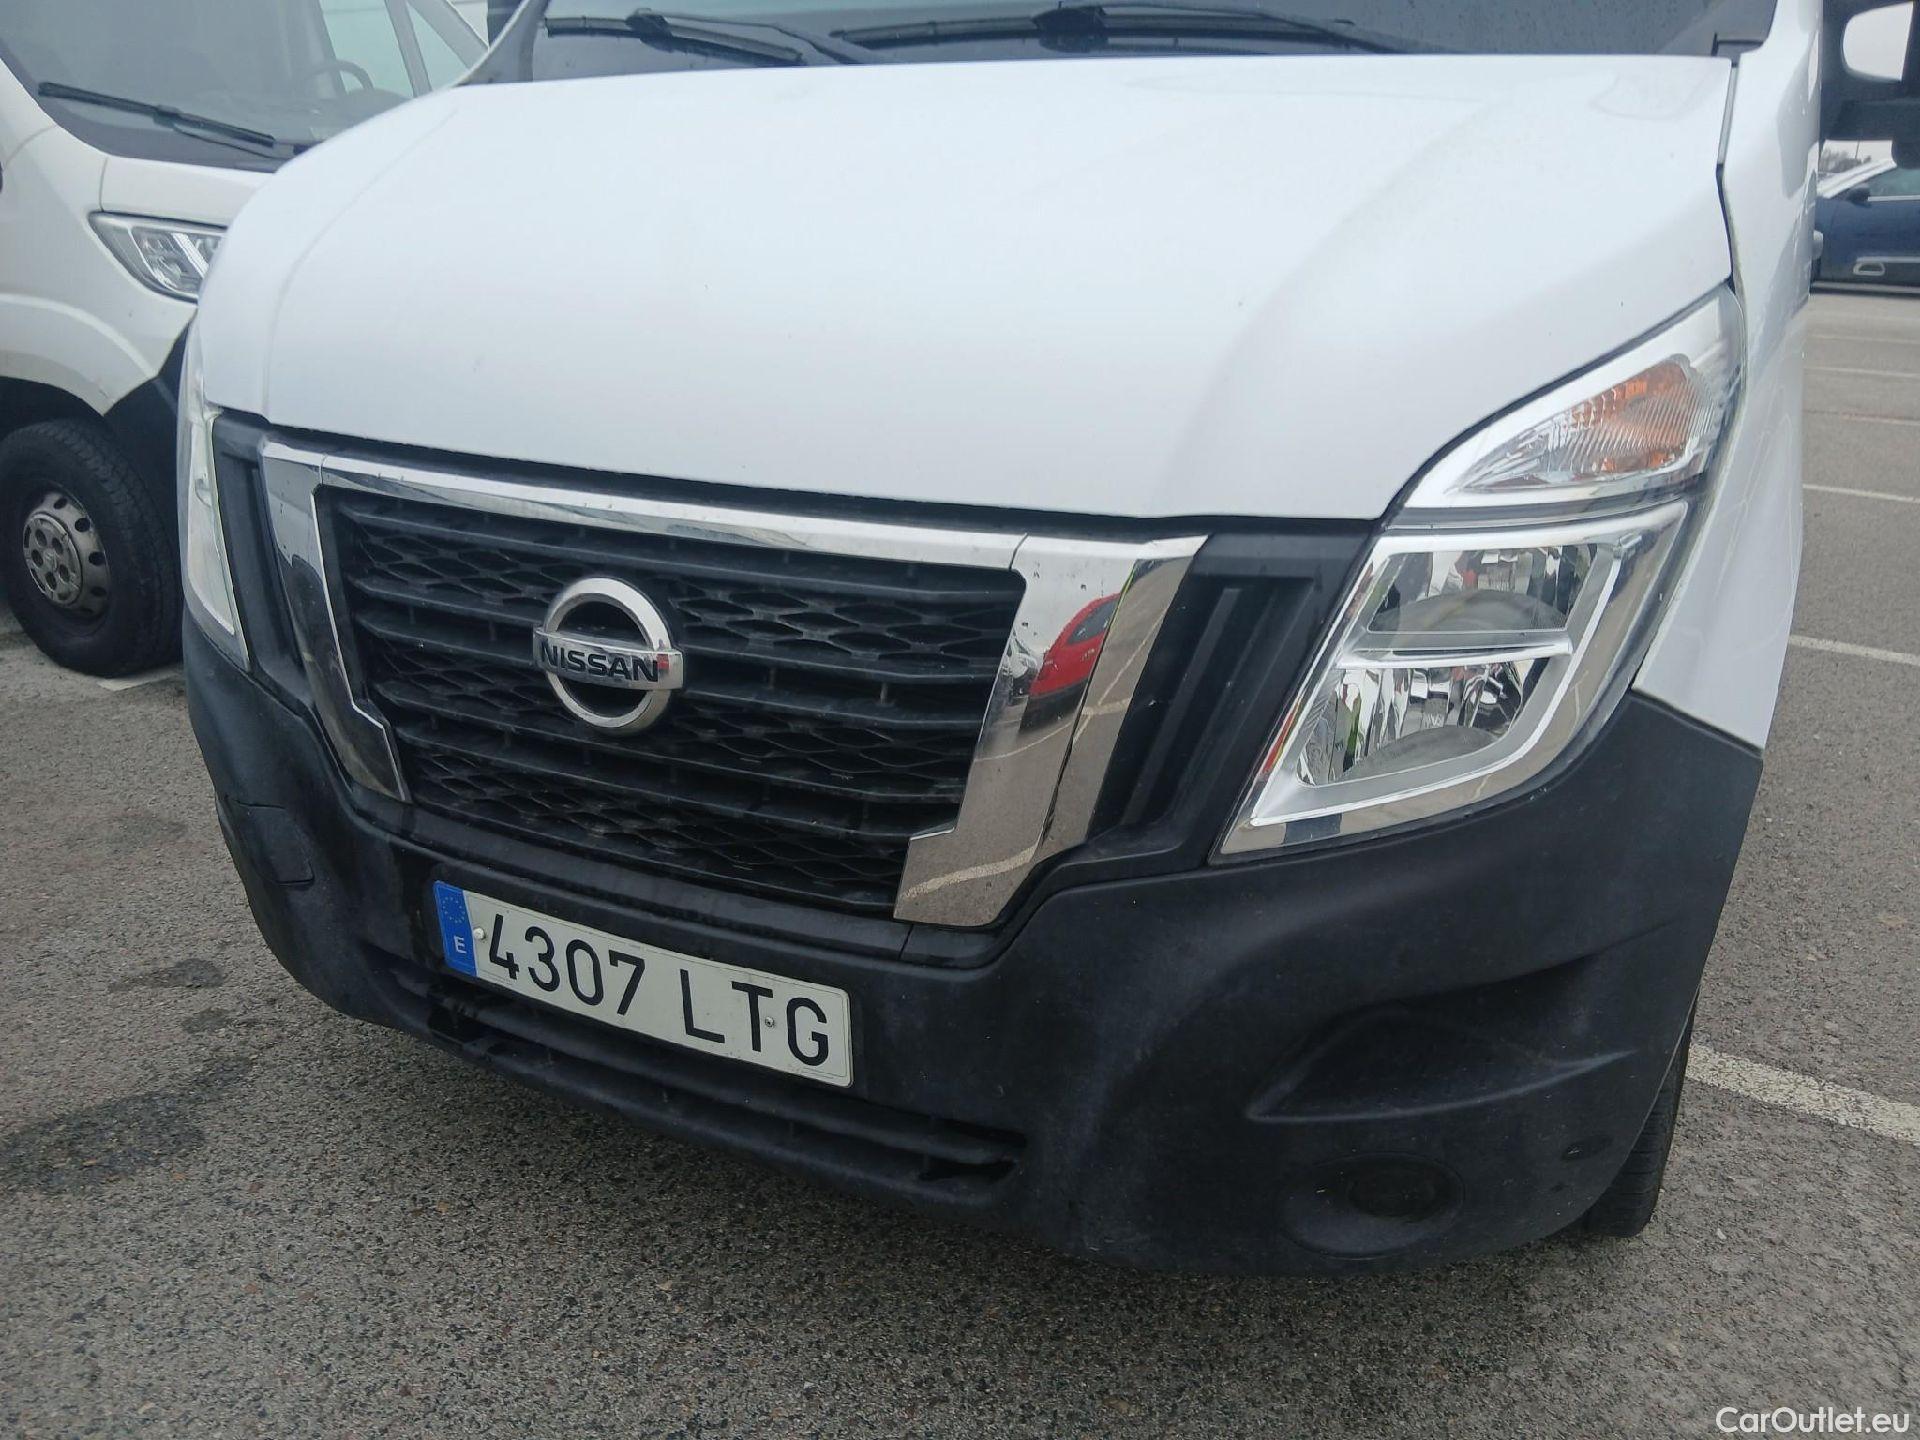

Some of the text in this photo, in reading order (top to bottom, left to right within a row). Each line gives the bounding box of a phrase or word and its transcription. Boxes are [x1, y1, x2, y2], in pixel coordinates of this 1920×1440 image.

[540, 640, 659, 682] NISSAN
[454, 936, 466, 954] E
[488, 913, 829, 1067] 4307 LTG
